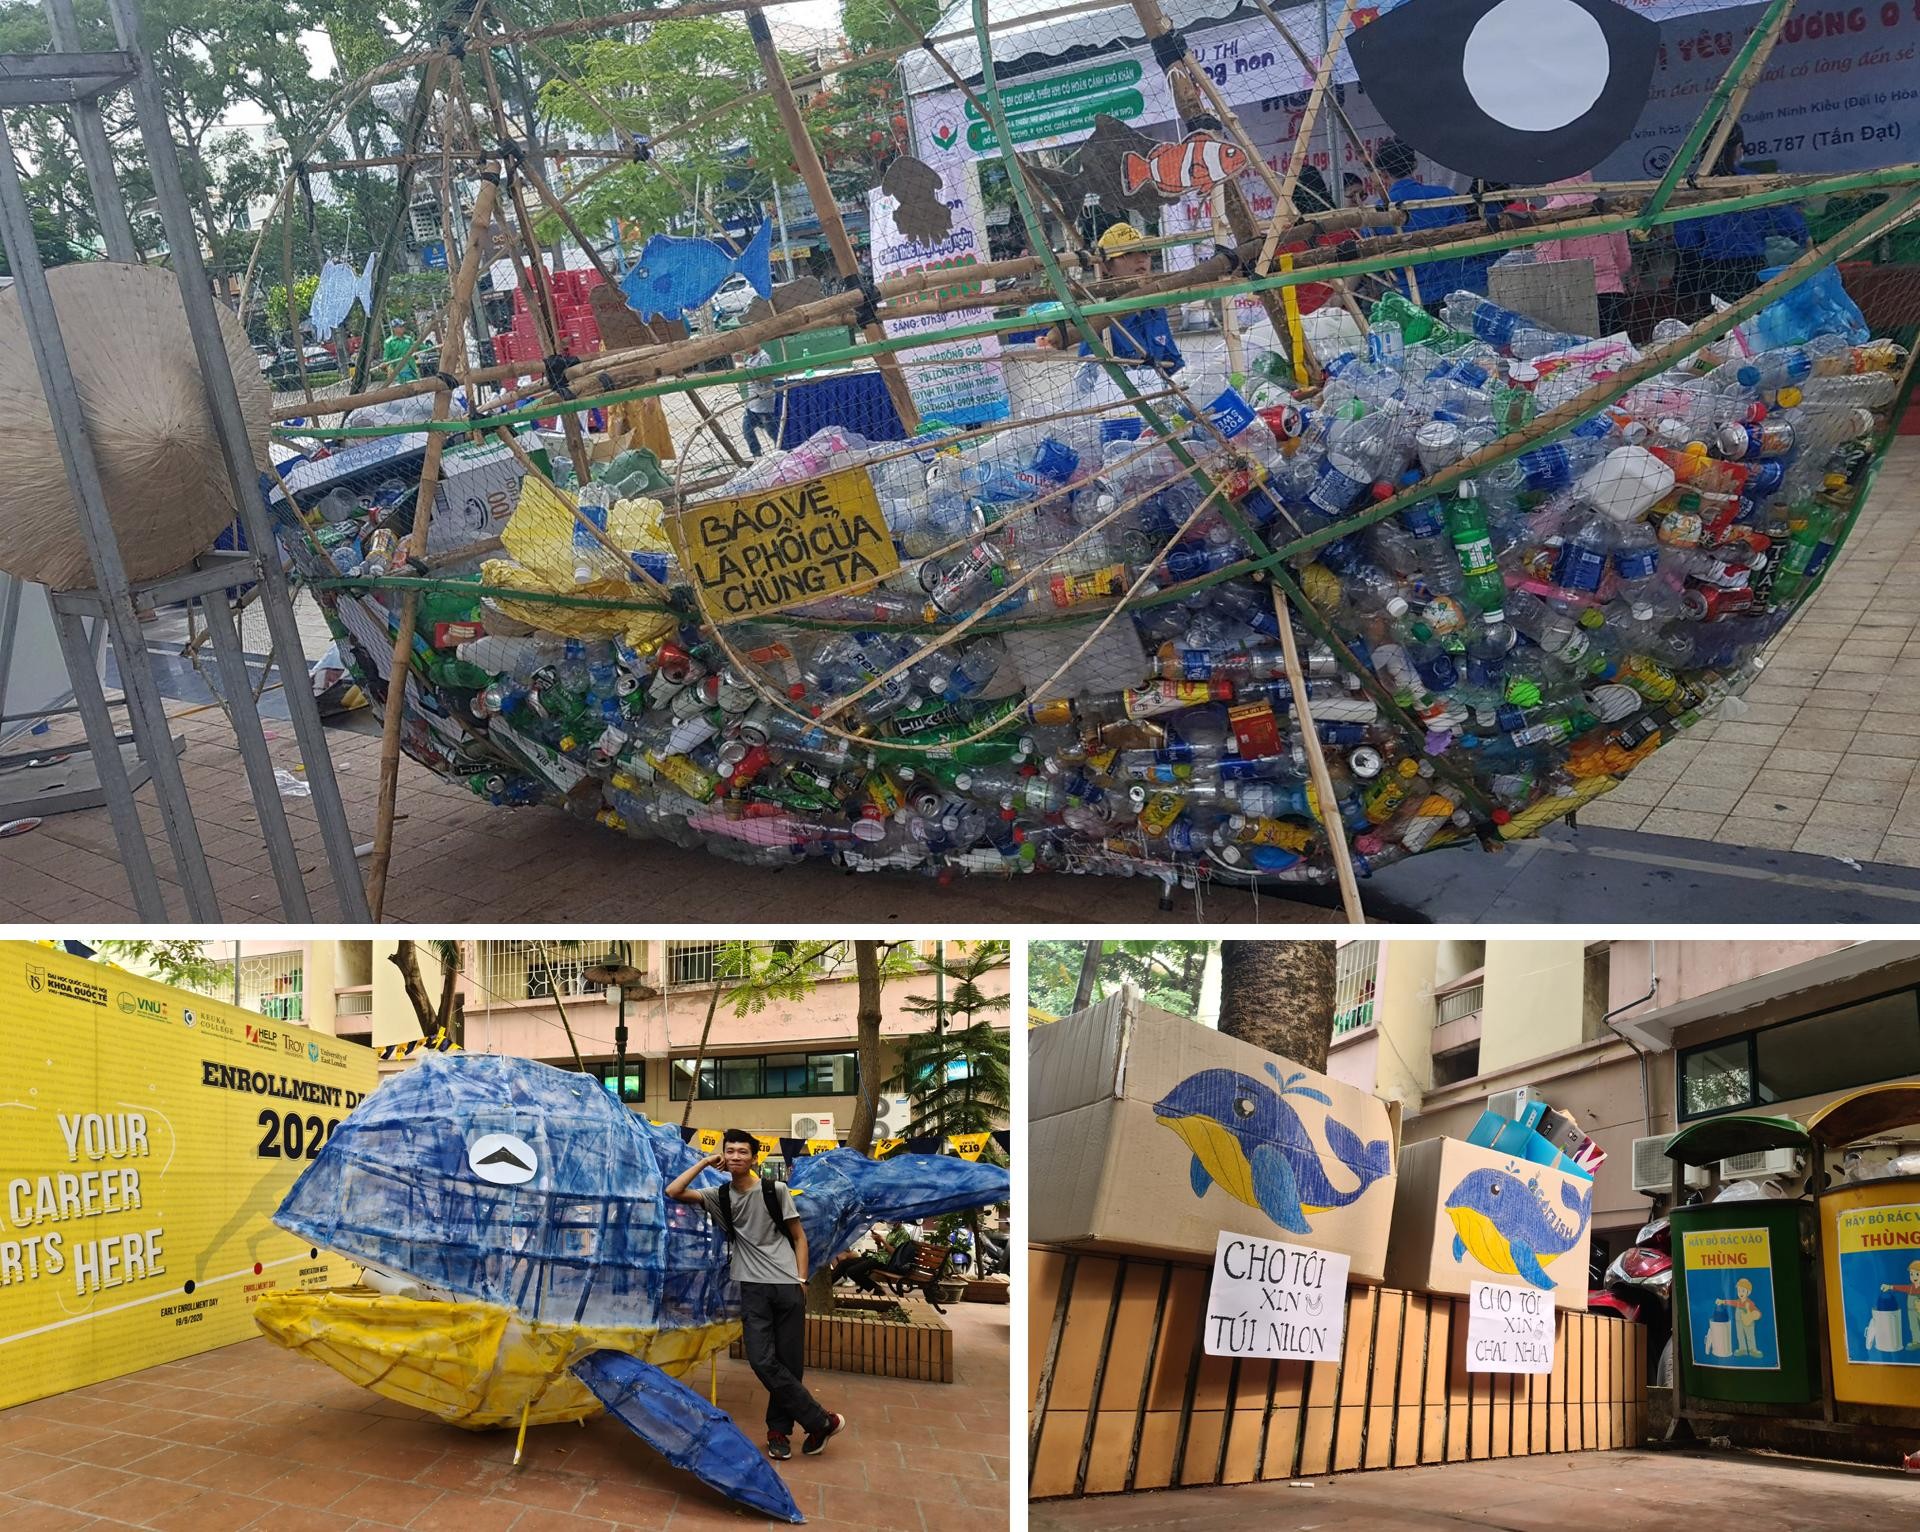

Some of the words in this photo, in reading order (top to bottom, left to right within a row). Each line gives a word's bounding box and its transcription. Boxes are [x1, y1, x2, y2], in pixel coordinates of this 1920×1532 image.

[701, 500, 783, 547] BẢO
[780, 480, 834, 518] VỆ
[694, 546, 746, 589] LÁ
[742, 517, 812, 577] PHỔI
[809, 508, 884, 556] CỦA
[723, 564, 826, 613] CHÚNG
[821, 550, 880, 585] TA
[48, 980, 72, 993] KHOA
[137, 997, 161, 1014] VNU
[200, 1021, 234, 1036] COLLEGE
[259, 1028, 277, 1041] HELP
[282, 1033, 305, 1054] TROY
[202, 1060, 343, 1108] ENROLLMENT
[346, 1090, 368, 1109] DA
[57, 1113, 149, 1161] YOUR
[959, 1144, 980, 1154] K19
[8, 1167, 142, 1228] CAREER
[1845, 1215, 1866, 1228] HÃY
[1868, 1211, 1884, 1225] BỎ
[1887, 1209, 1912, 1223] RÁC
[1689, 1237, 1706, 1248] HÃY
[1706, 1235, 1718, 1246] BỎ
[1720, 1234, 1739, 1246] RÁC
[1742, 1233, 1763, 1245] VÀO
[1861, 1228, 1920, 1248] THÙNG
[0, 1231, 66, 1288] RTS
[74, 1227, 166, 1296] HERE
[1223, 1241, 1286, 1284] CHO
[1291, 1251, 1326, 1289] TÔI
[1701, 1250, 1748, 1267] THÙNG
[161, 1306, 177, 1318] EARLY
[177, 1299, 209, 1314] ENROLLMENT
[209, 1298, 219, 1307] DAY
[1260, 1287, 1301, 1312] XIN
[1480, 1286, 1512, 1312] CHO
[1519, 1291, 1541, 1315] TÔI
[1211, 1311, 1257, 1352] TÚI
[1266, 1322, 1327, 1354] NILON
[1504, 1316, 1533, 1333] XIN
[1475, 1340, 1507, 1362] CHAI
